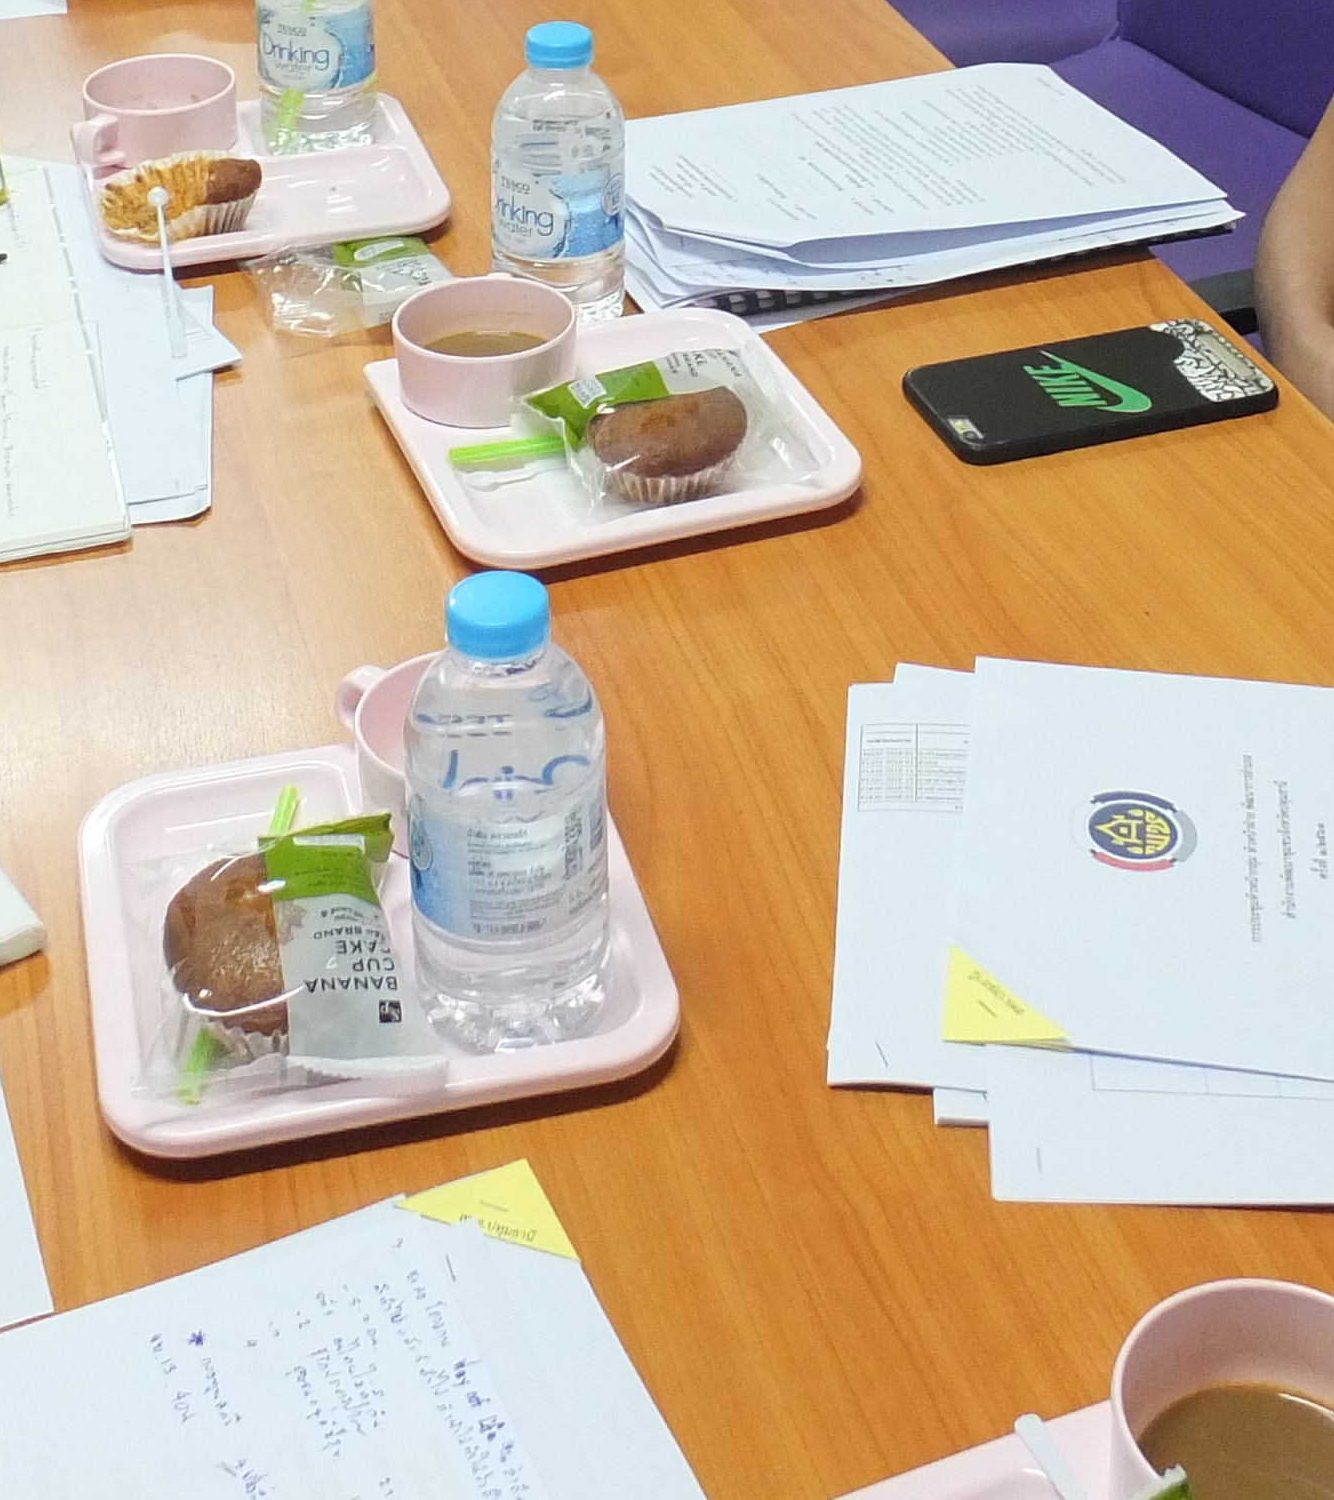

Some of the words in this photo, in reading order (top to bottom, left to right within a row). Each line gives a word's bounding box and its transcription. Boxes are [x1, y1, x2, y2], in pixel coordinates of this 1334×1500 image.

[263, 33, 329, 71] Drinking
[494, 196, 554, 236] rinking
[1023, 365, 1107, 407] NIKE
[351, 957, 394, 971] CUP
[303, 975, 397, 993] BANANA
